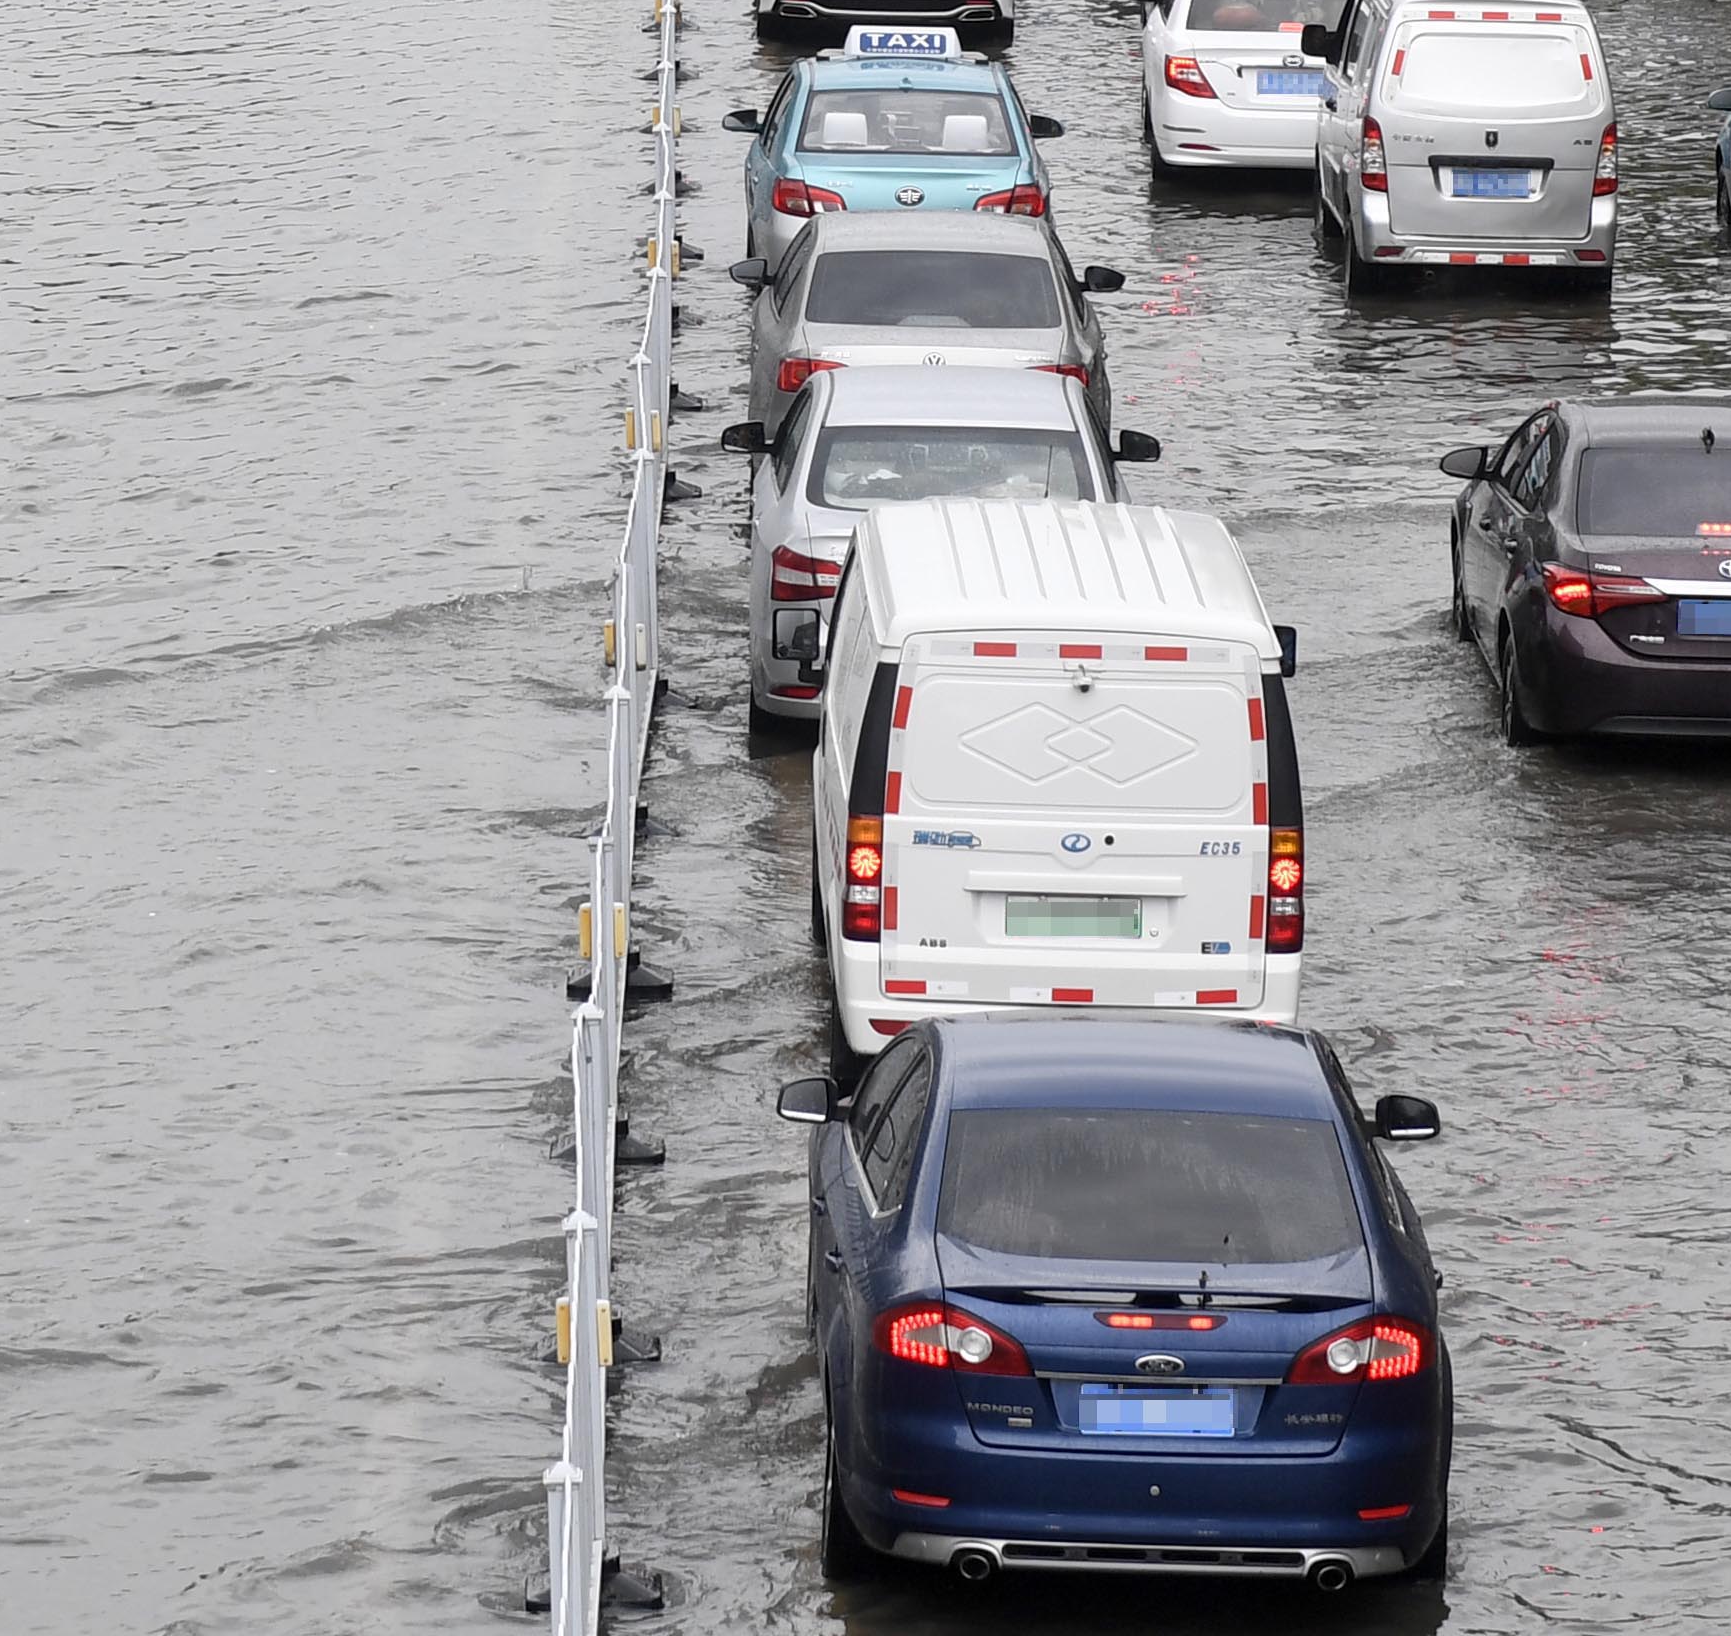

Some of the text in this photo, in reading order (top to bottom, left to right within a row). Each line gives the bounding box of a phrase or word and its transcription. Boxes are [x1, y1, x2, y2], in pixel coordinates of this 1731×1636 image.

[867, 34, 941, 48] TAXI
[1199, 841, 1241, 856] EC35
[919, 937, 947, 948] ABS
[967, 1402, 1034, 1415] MONDEO
